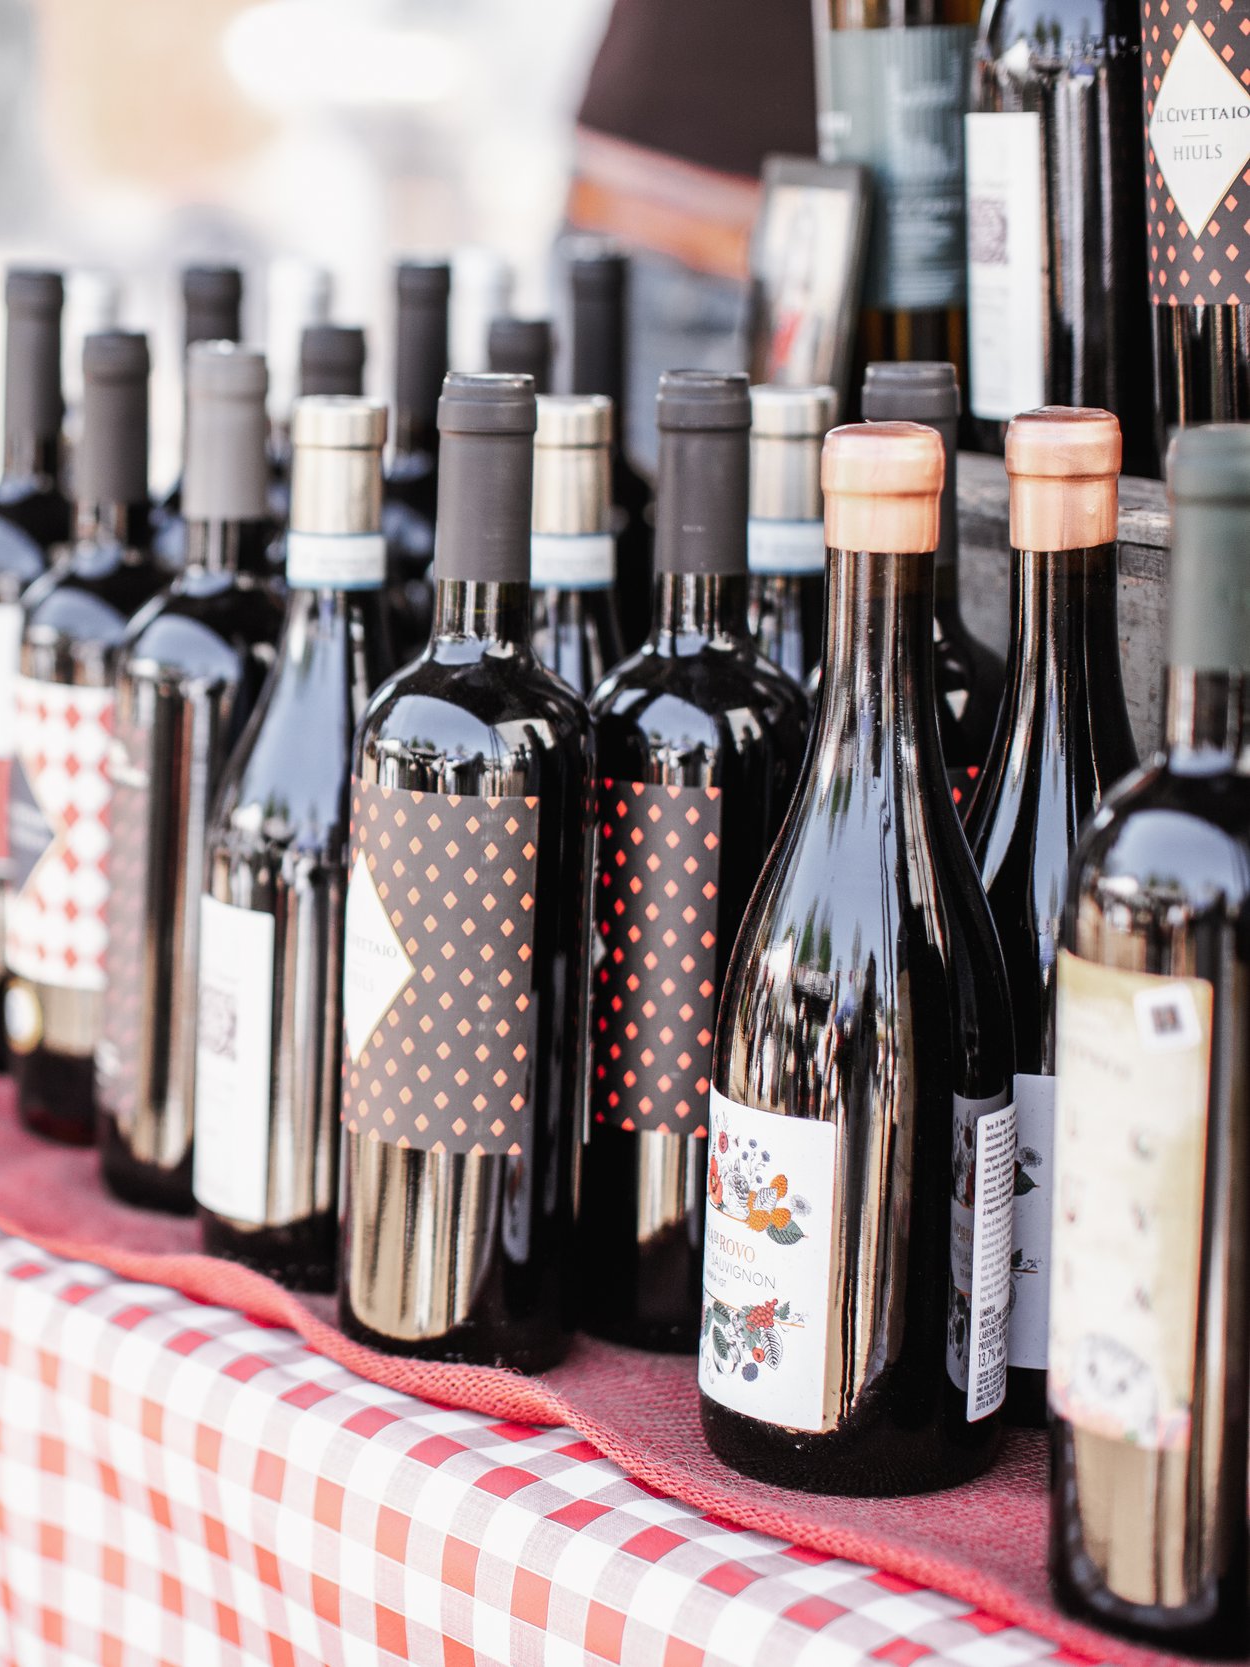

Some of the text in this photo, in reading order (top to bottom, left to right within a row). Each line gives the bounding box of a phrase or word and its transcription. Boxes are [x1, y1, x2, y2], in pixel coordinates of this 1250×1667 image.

[1166, 105, 1250, 122] CIVETTAIO
[1173, 143, 1223, 161] HIULS
[719, 1234, 756, 1264] ROVO
[711, 1251, 776, 1290] SAUVIGNON
